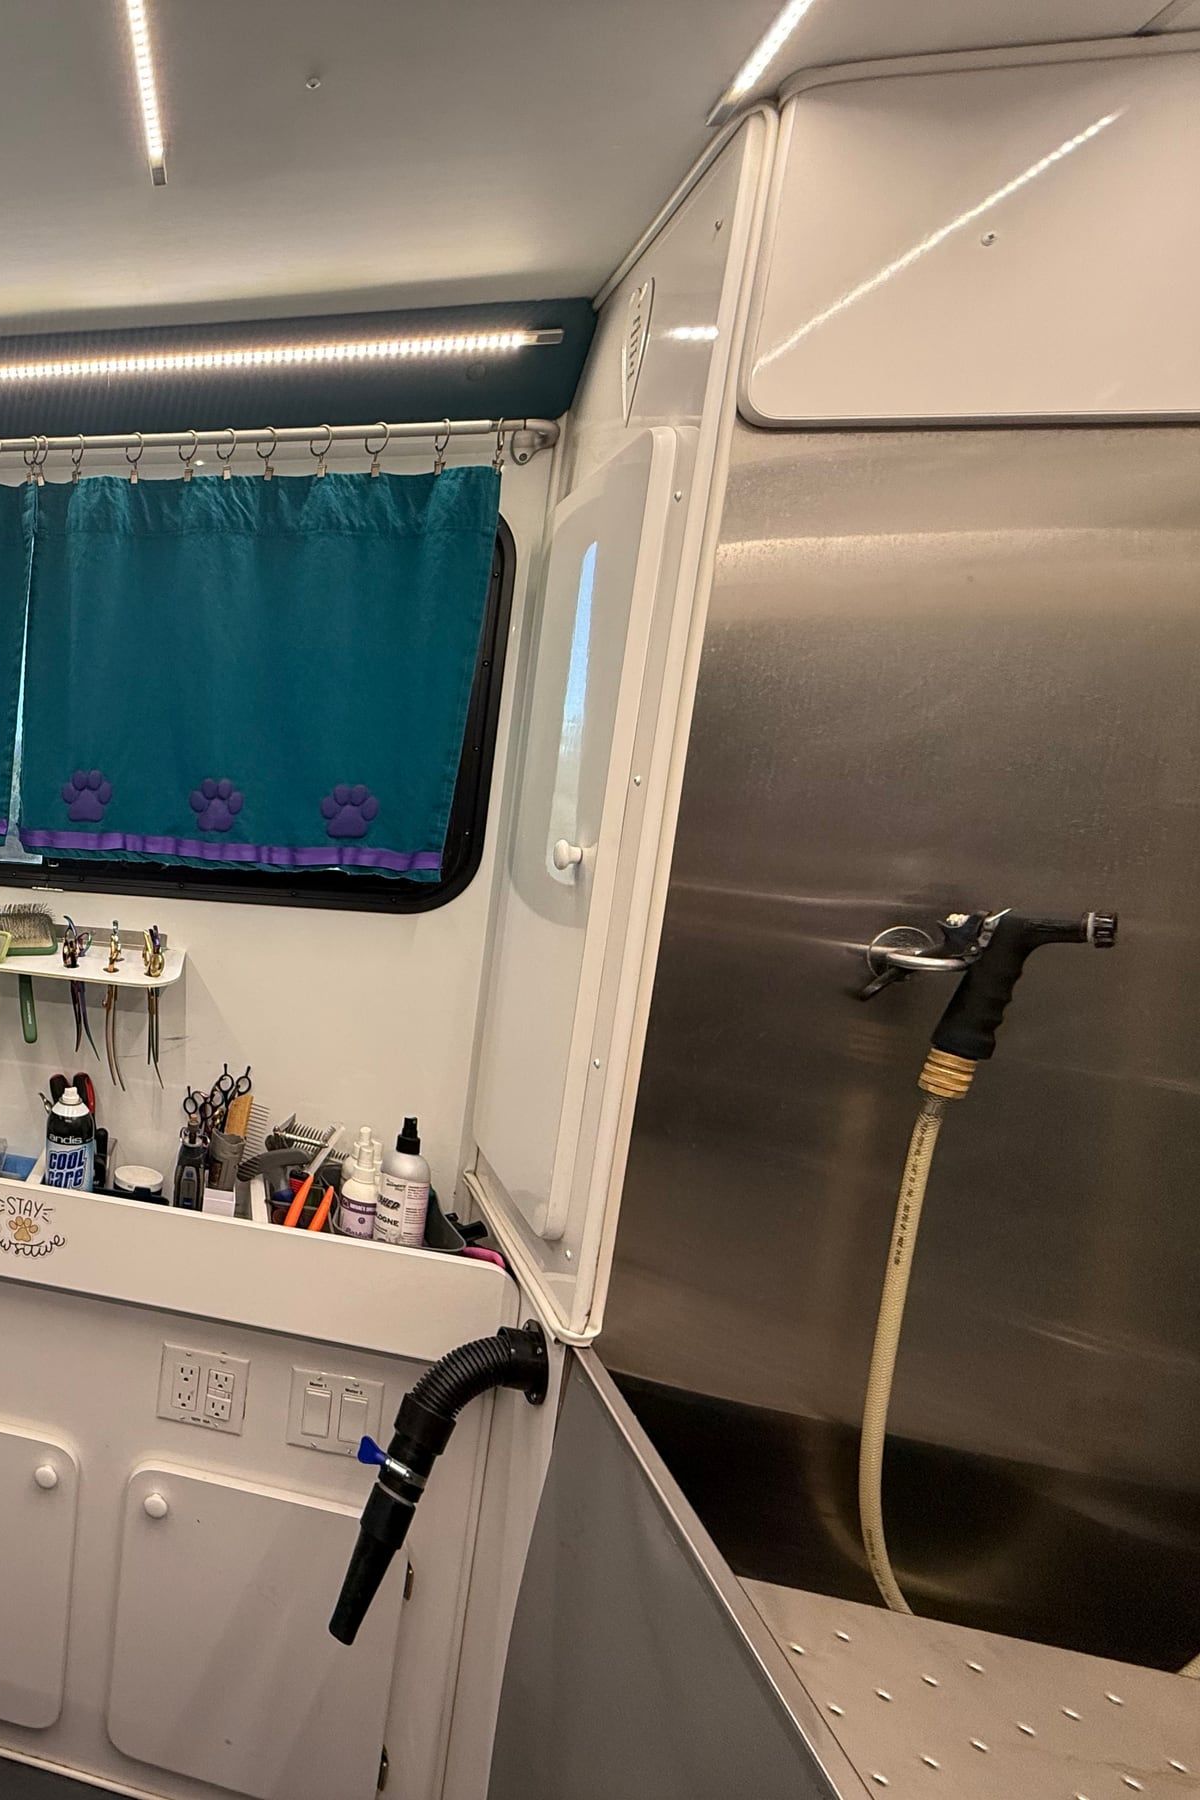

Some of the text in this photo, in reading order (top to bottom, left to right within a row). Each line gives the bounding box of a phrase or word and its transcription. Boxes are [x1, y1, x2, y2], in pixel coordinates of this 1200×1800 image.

[48, 1133, 83, 1145] andis
[48, 1149, 86, 1171] COOL
[6, 1196, 44, 1218] STAY
